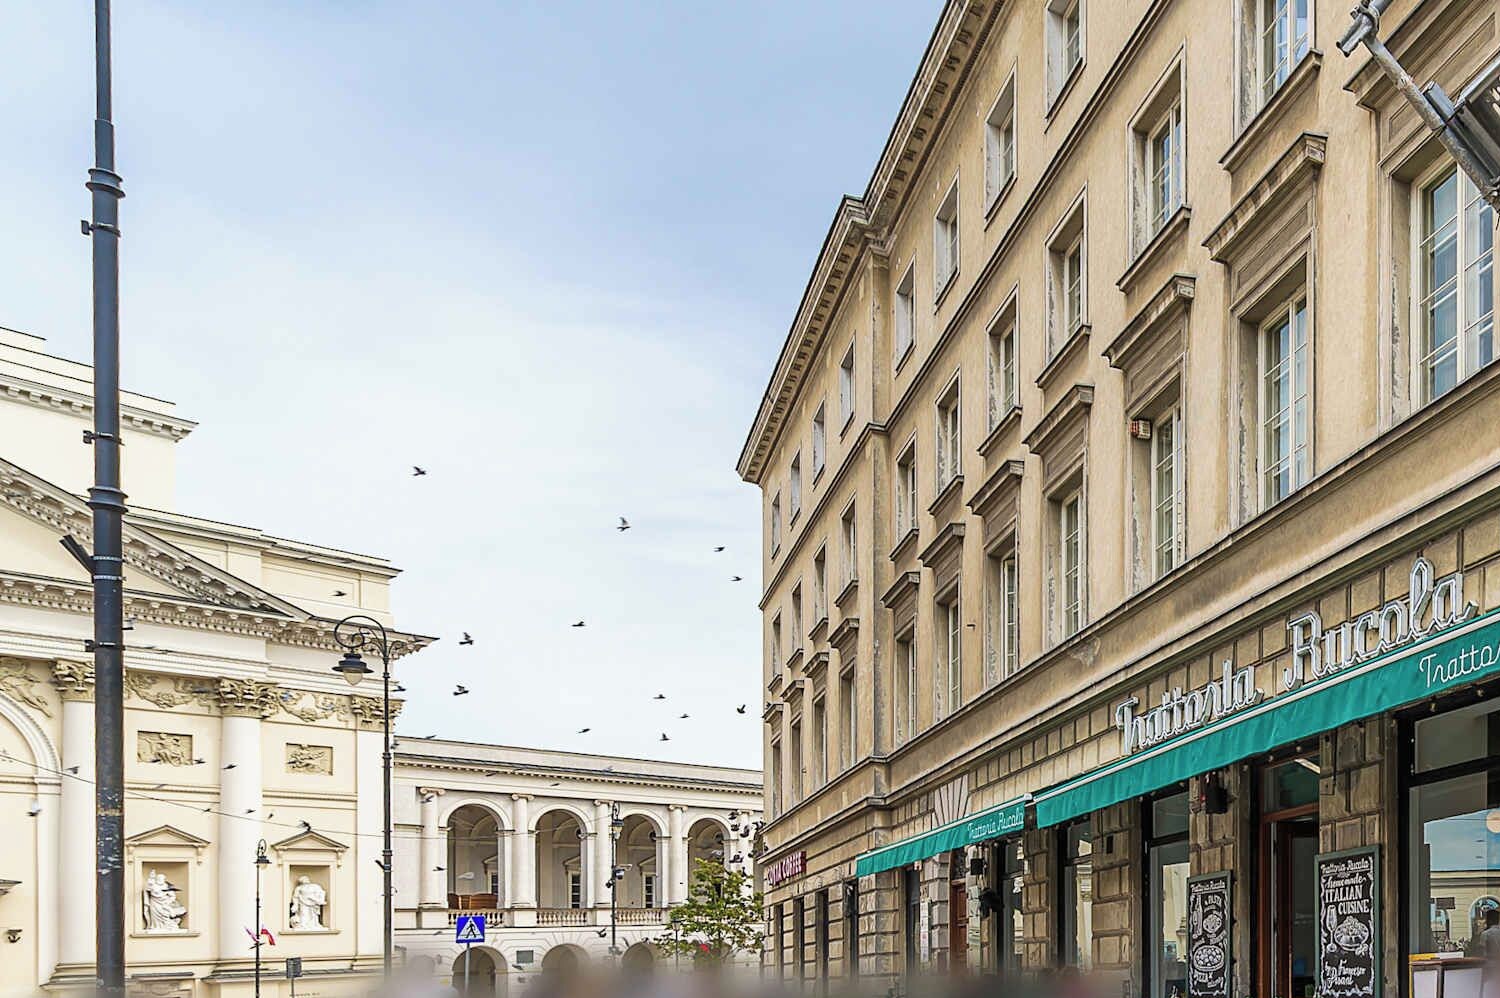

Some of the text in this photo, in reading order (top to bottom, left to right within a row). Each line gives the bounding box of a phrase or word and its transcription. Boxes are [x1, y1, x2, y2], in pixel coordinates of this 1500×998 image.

[1115, 555, 1479, 756] Trattoria Rucola
[1325, 885, 1363, 903] ITALIAN
[1338, 899, 1370, 915] CUISINE
